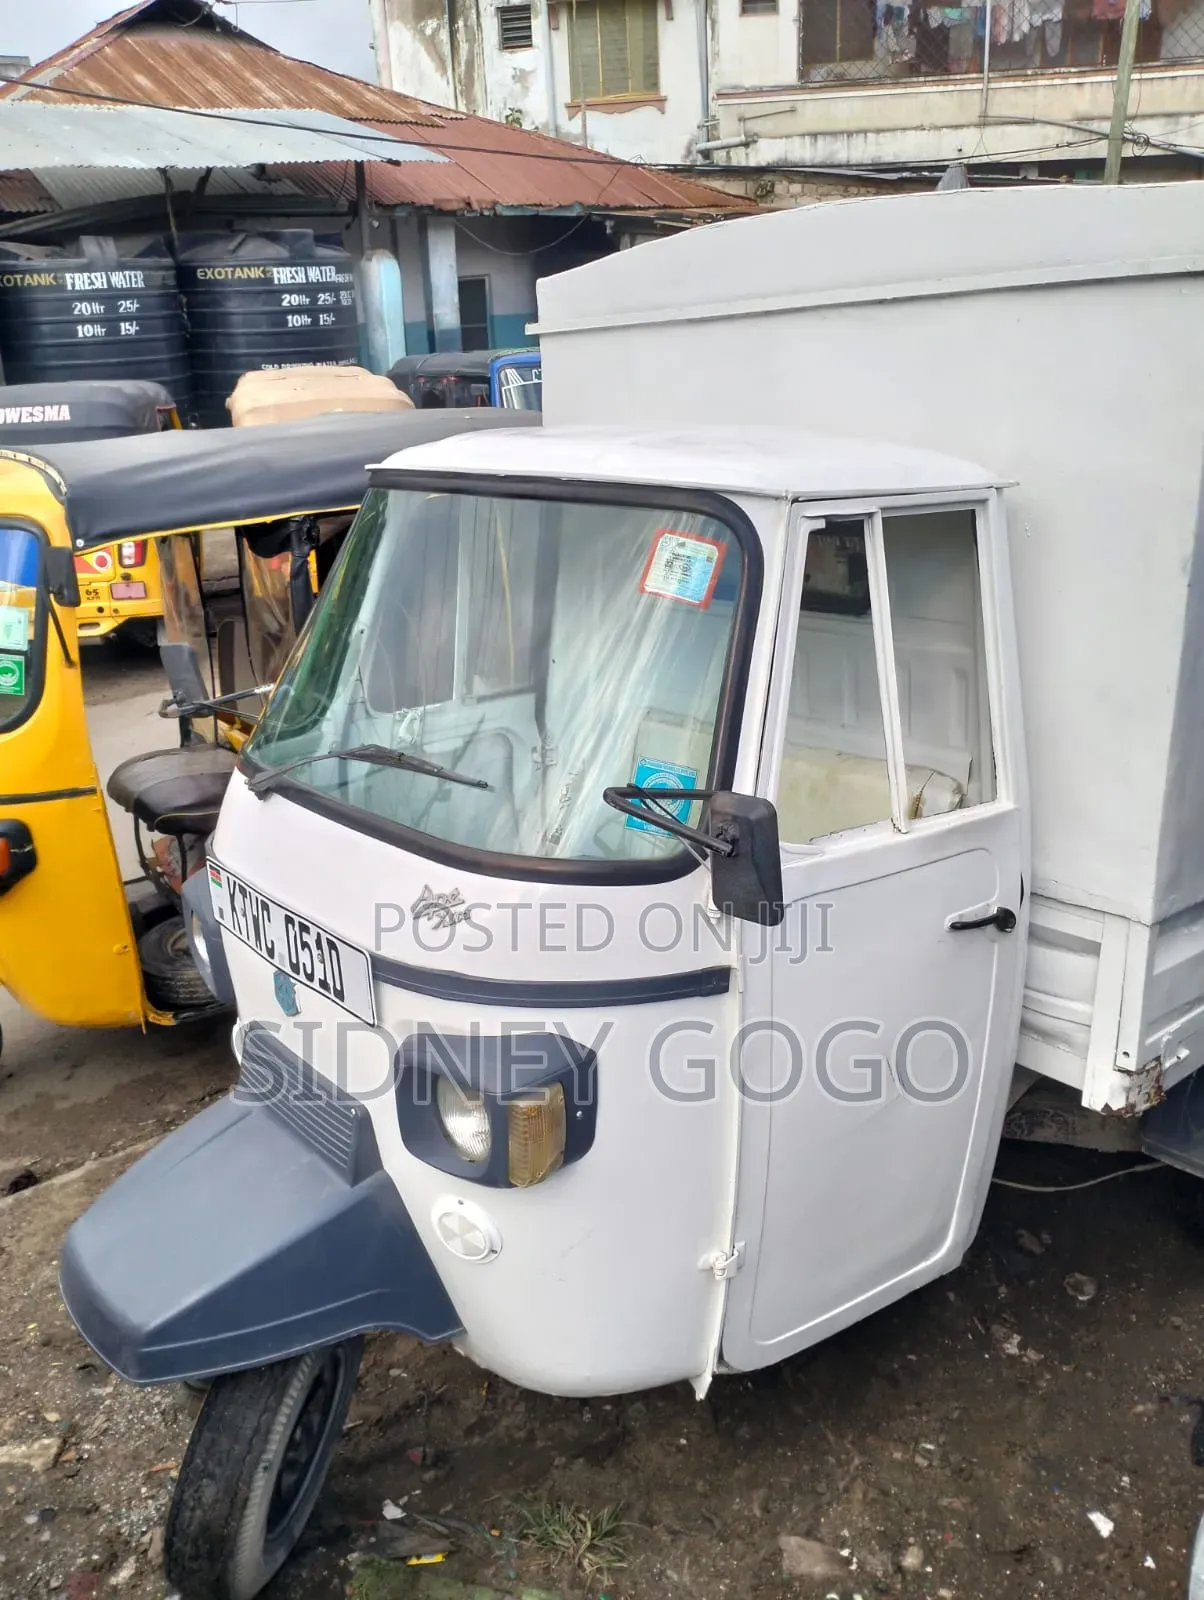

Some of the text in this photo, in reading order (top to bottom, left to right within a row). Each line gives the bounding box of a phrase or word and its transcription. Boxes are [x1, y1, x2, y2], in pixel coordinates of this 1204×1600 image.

[196, 266, 265, 279] EXOTANK
[273, 266, 336, 284] FRESH WATER
[65, 270, 146, 290] FRESH WATER
[317, 292, 337, 305] 25/-
[117, 299, 140, 313] 25/-
[319, 312, 336, 325] 15/-
[119, 320, 140, 335] 15/-
[226, 875, 345, 1003] KTWC 051D
